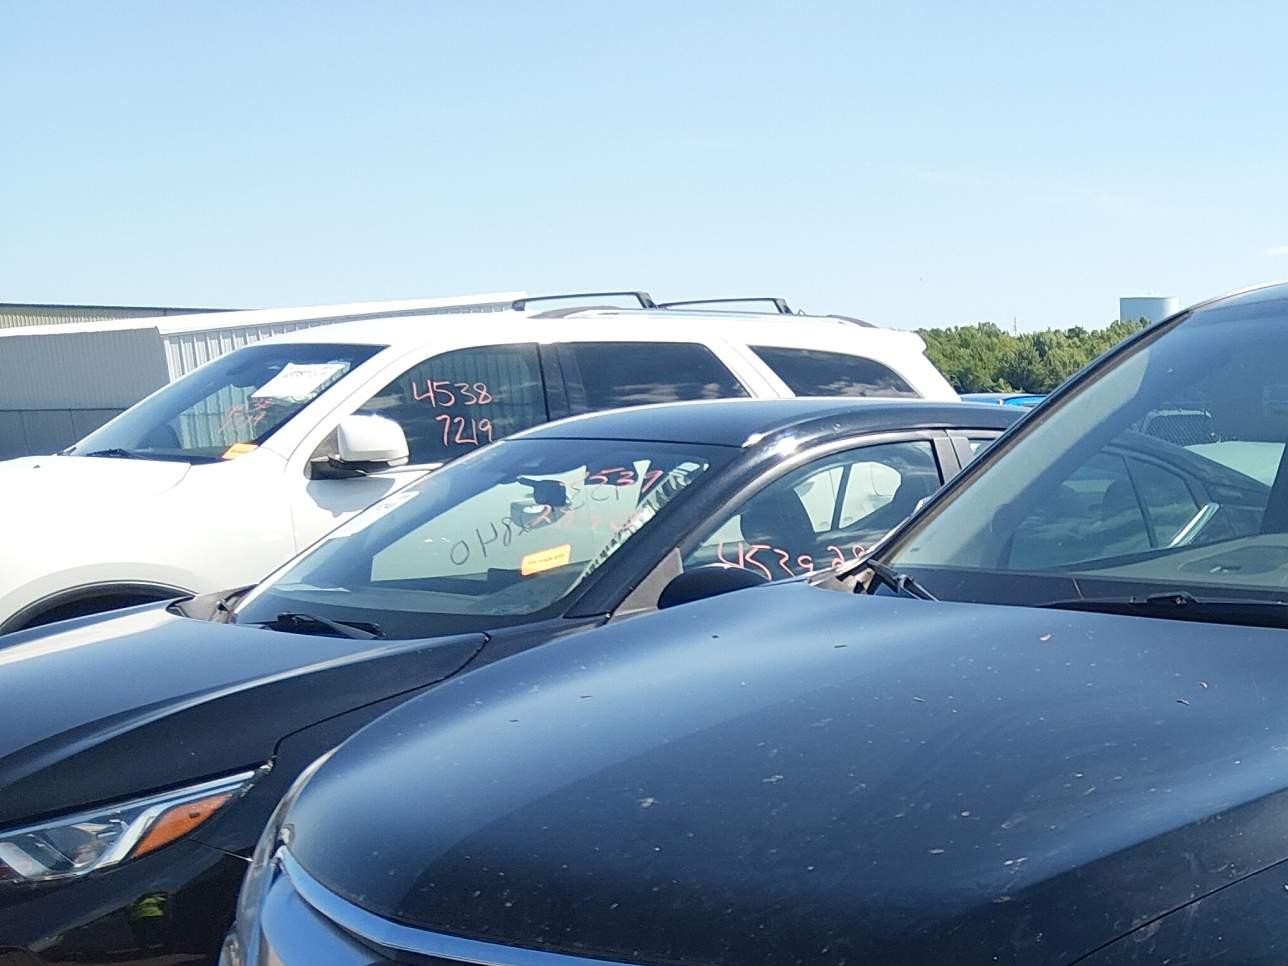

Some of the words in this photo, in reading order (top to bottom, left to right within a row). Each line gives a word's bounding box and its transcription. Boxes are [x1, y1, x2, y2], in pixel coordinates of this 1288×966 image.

[411, 379, 493, 408] 4538
[436, 414, 493, 447] 7219
[717, 541, 814, 582] 4539
